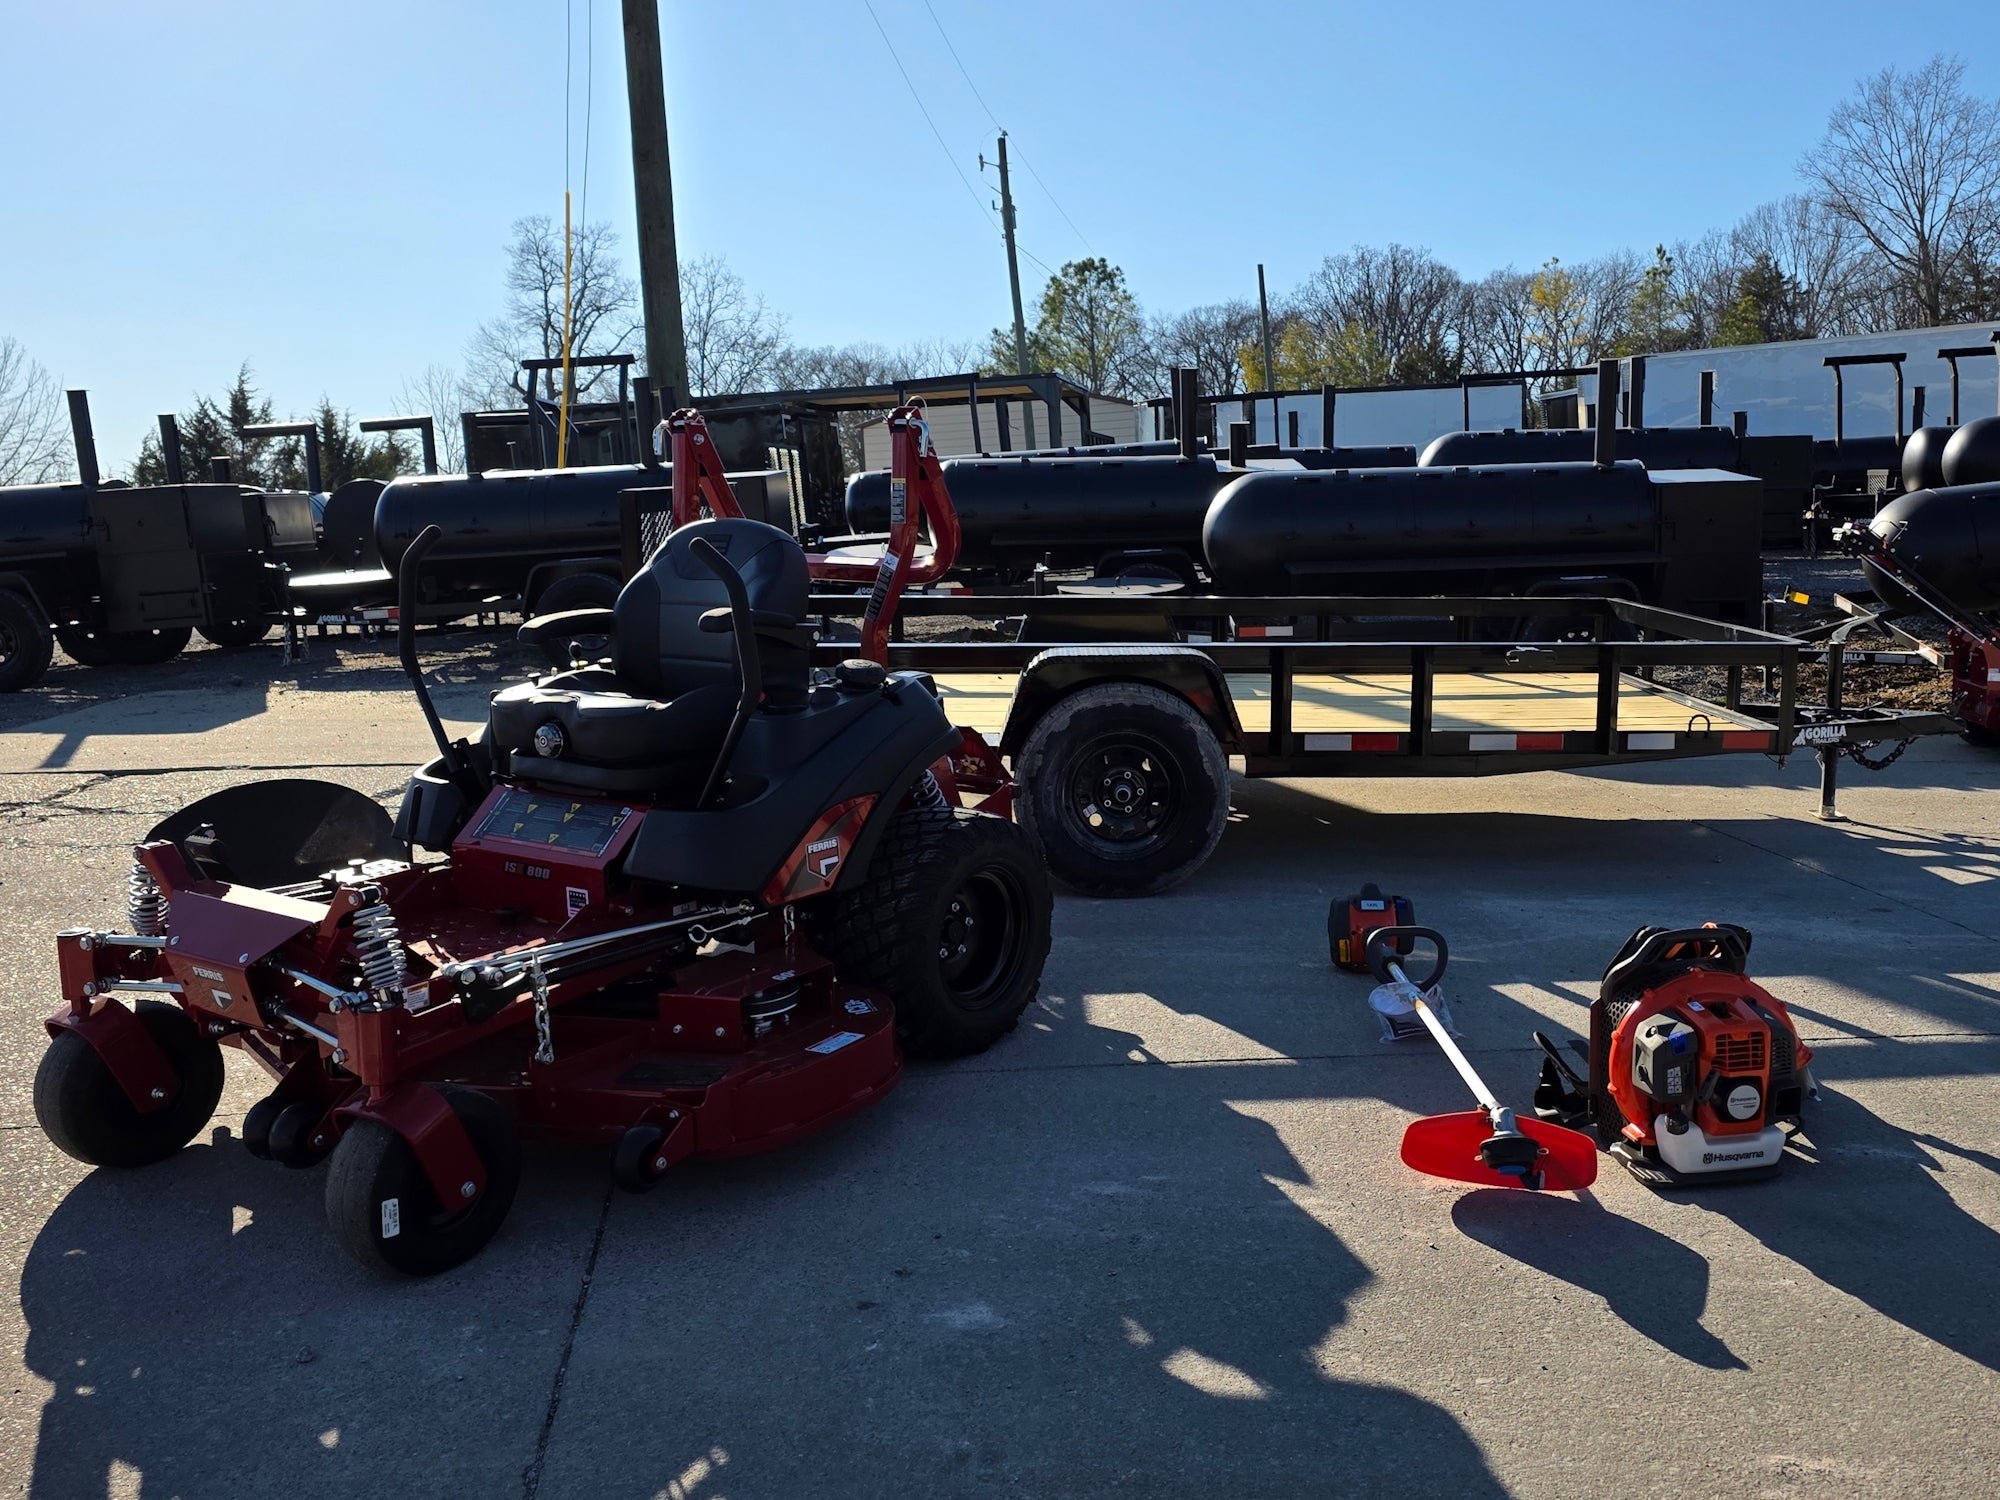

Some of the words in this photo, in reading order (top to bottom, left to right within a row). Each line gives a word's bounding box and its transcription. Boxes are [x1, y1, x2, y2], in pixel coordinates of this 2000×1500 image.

[1805, 725, 1847, 740] GORILLA
[807, 838, 838, 854] FERRIS
[526, 865, 551, 880] 800
[191, 966, 225, 982] FERRIS
[1713, 1150, 1764, 1163] Husqvarna
